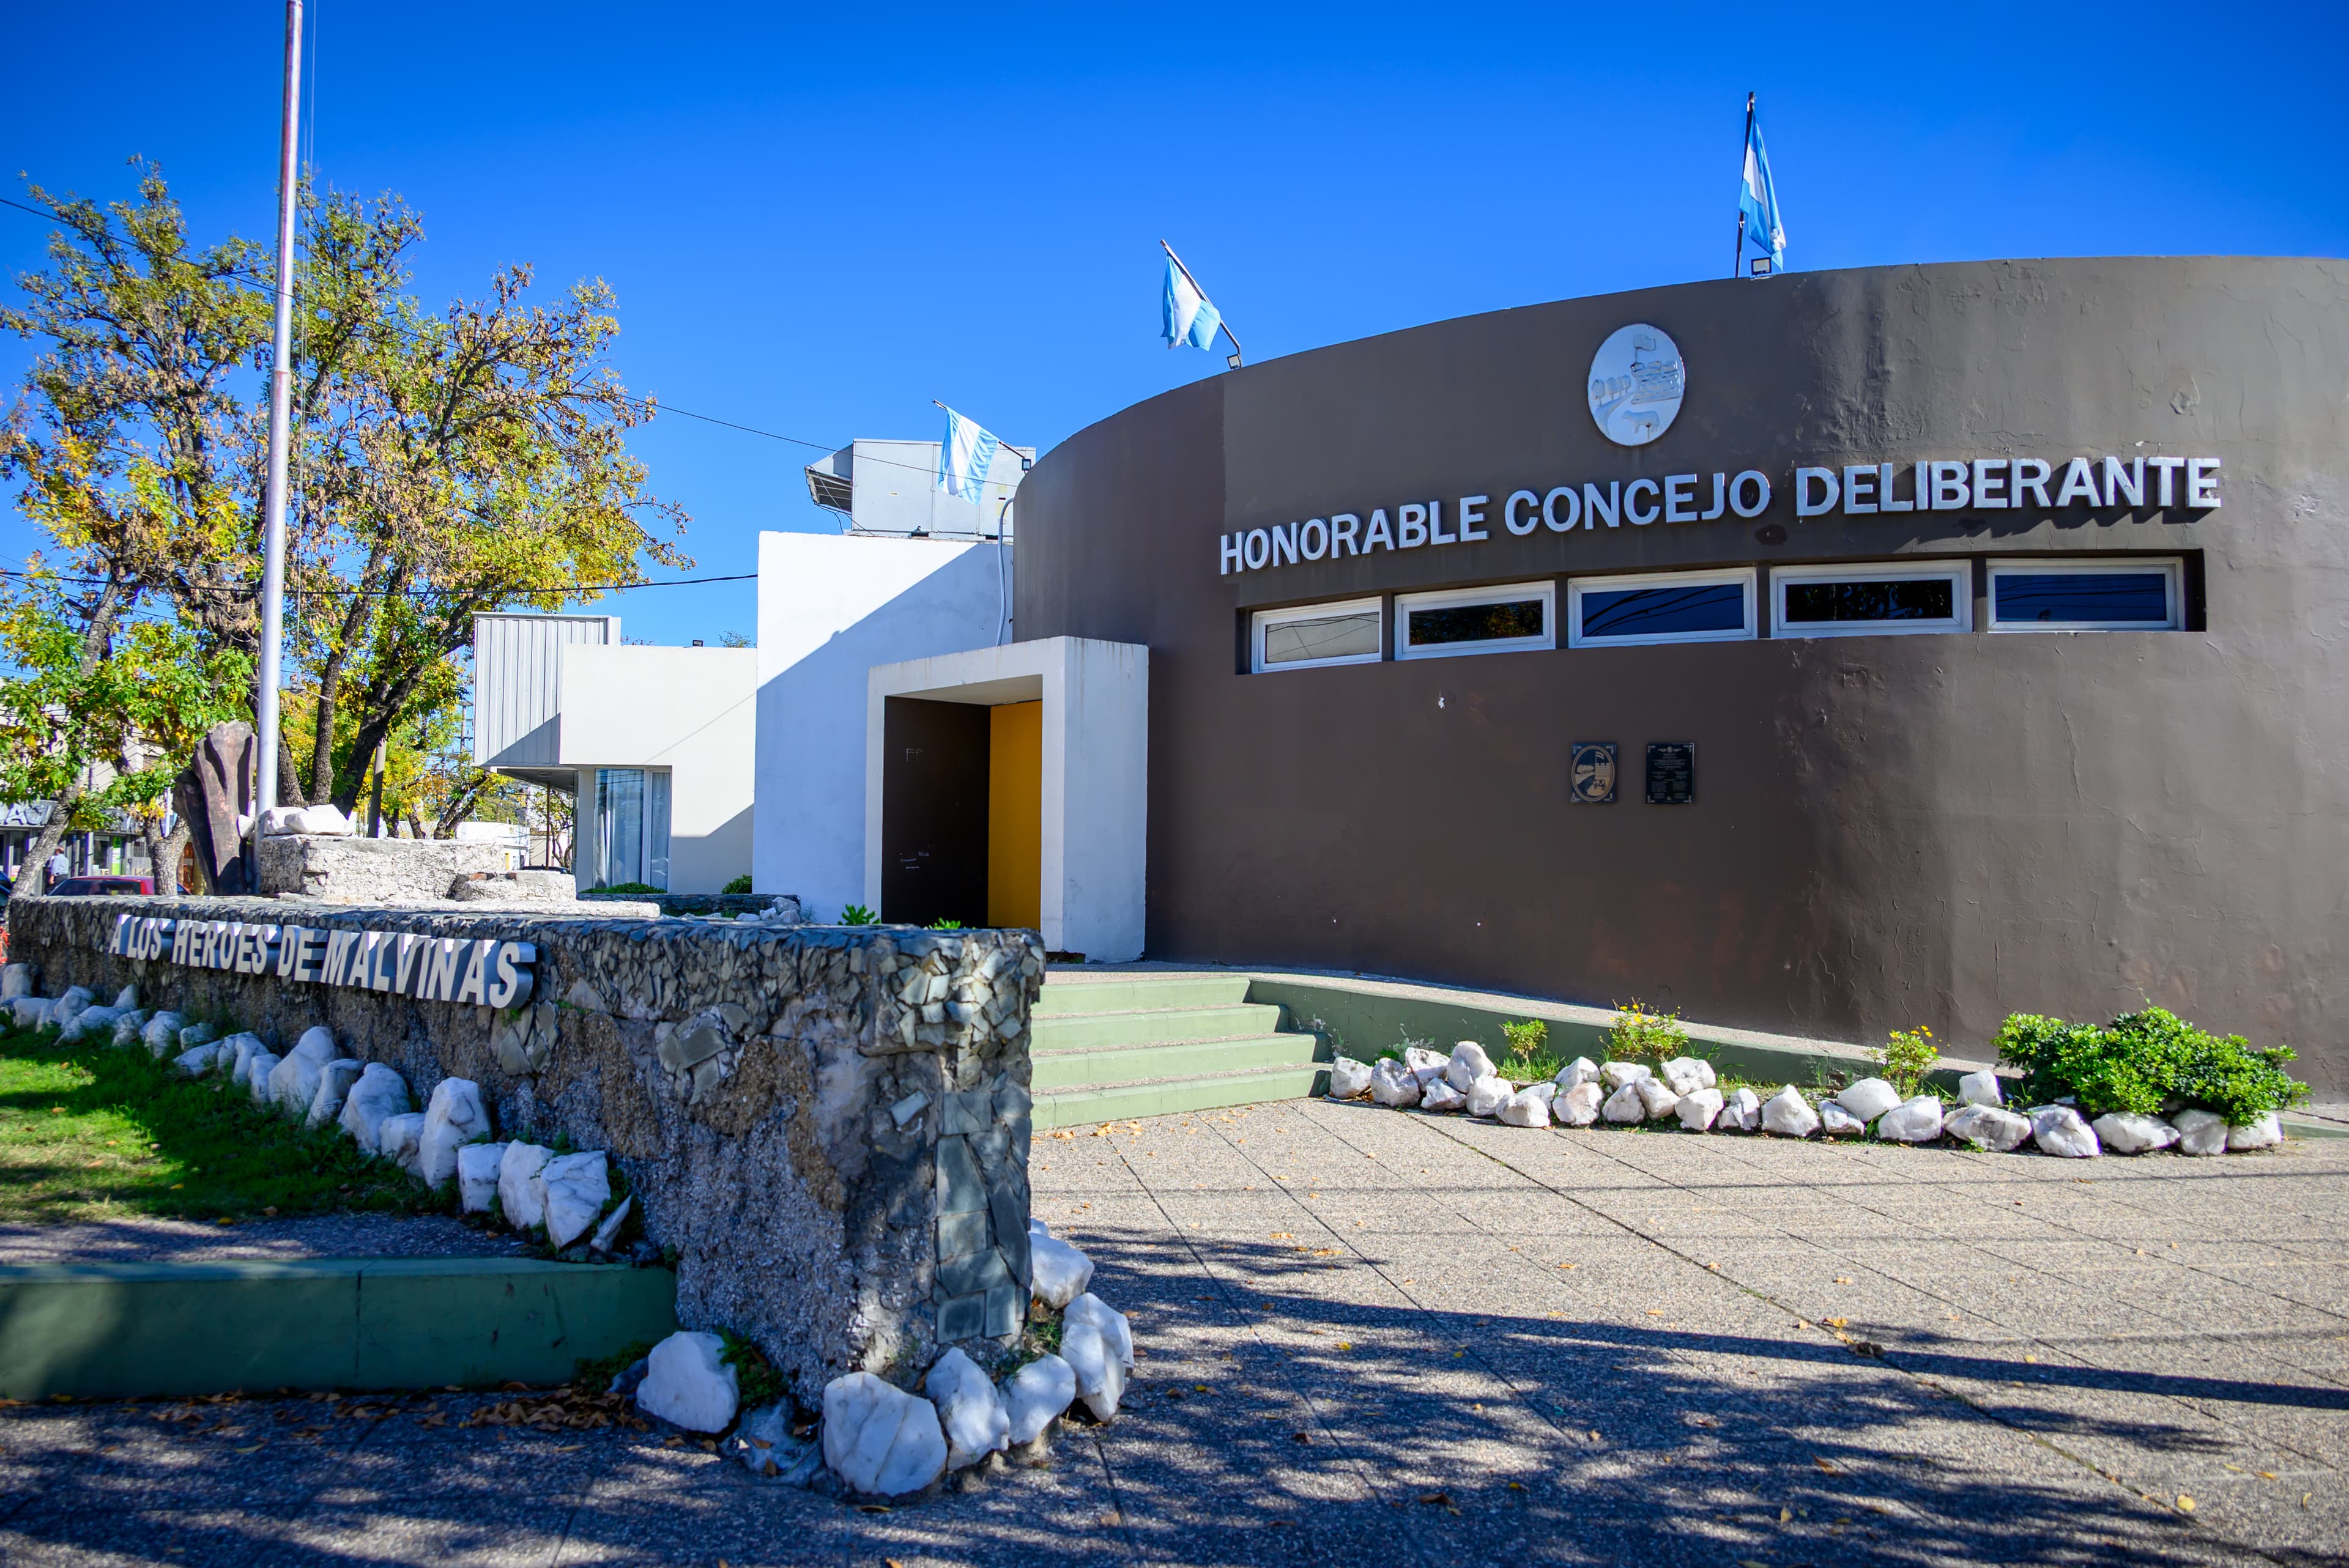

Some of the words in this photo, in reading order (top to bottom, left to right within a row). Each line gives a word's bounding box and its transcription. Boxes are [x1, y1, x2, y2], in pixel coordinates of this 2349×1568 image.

[1220, 495, 1490, 575] HONORABLE
[1504, 470, 1770, 536] CONCEJO
[1796, 456, 2222, 517] DELIBERANTE
[109, 915, 125, 955] A
[127, 917, 165, 960] LOS
[172, 920, 272, 975] HEROES
[277, 925, 318, 982] DE
[321, 930, 530, 1009] MALVINAS
